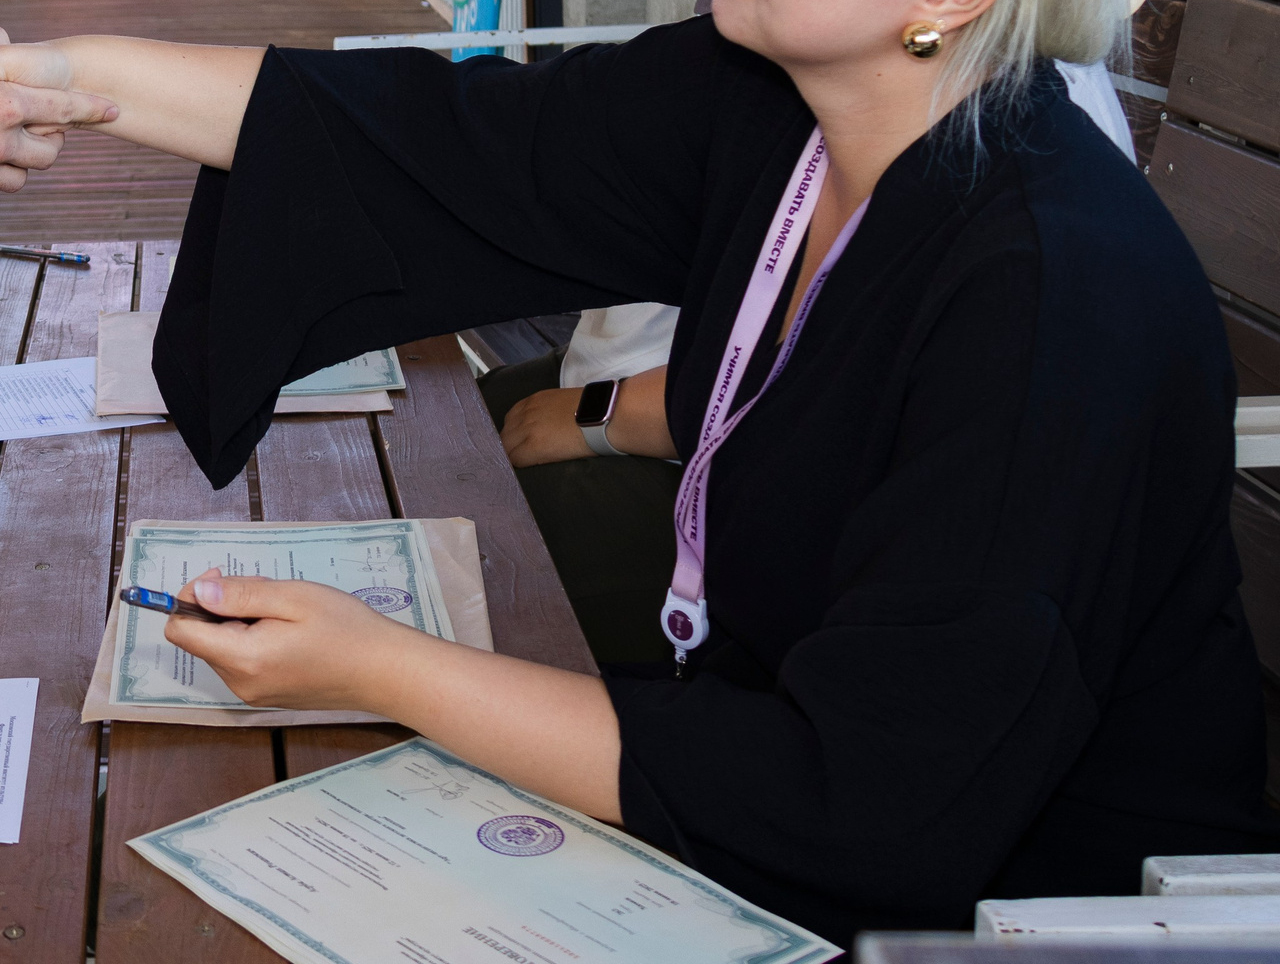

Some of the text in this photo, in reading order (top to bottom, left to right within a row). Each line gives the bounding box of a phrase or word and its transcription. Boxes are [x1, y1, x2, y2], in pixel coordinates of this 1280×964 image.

[764, 217, 794, 275] ВМЕСТЕ
[717, 346, 742, 404] УЧИМСЯ
[703, 404, 720, 443] СОЗД
[689, 487, 703, 542] ВМЕСТЕ
